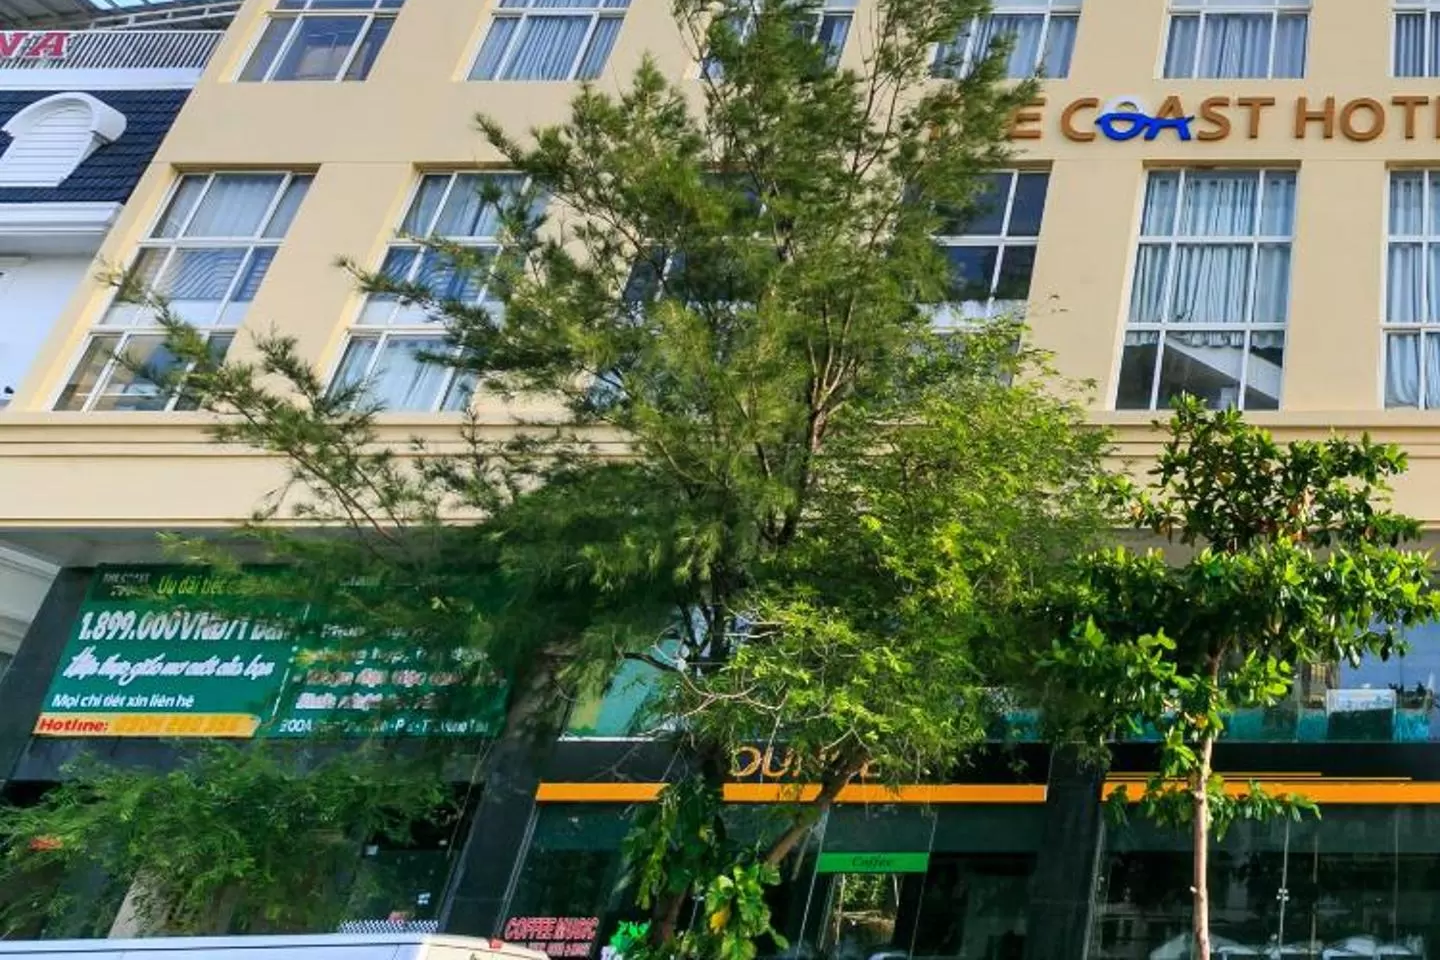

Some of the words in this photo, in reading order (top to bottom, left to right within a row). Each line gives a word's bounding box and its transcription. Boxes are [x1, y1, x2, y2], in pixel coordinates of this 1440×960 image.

[1060, 94, 1275, 143] COAST
[51, 692, 78, 708] Mọi
[79, 692, 101, 708] chi
[126, 692, 149, 708] xin
[149, 692, 177, 708] liên
[178, 692, 195, 708] hệ
[39, 718, 109, 733] Hotline:
[504, 917, 557, 941] COFFEE
